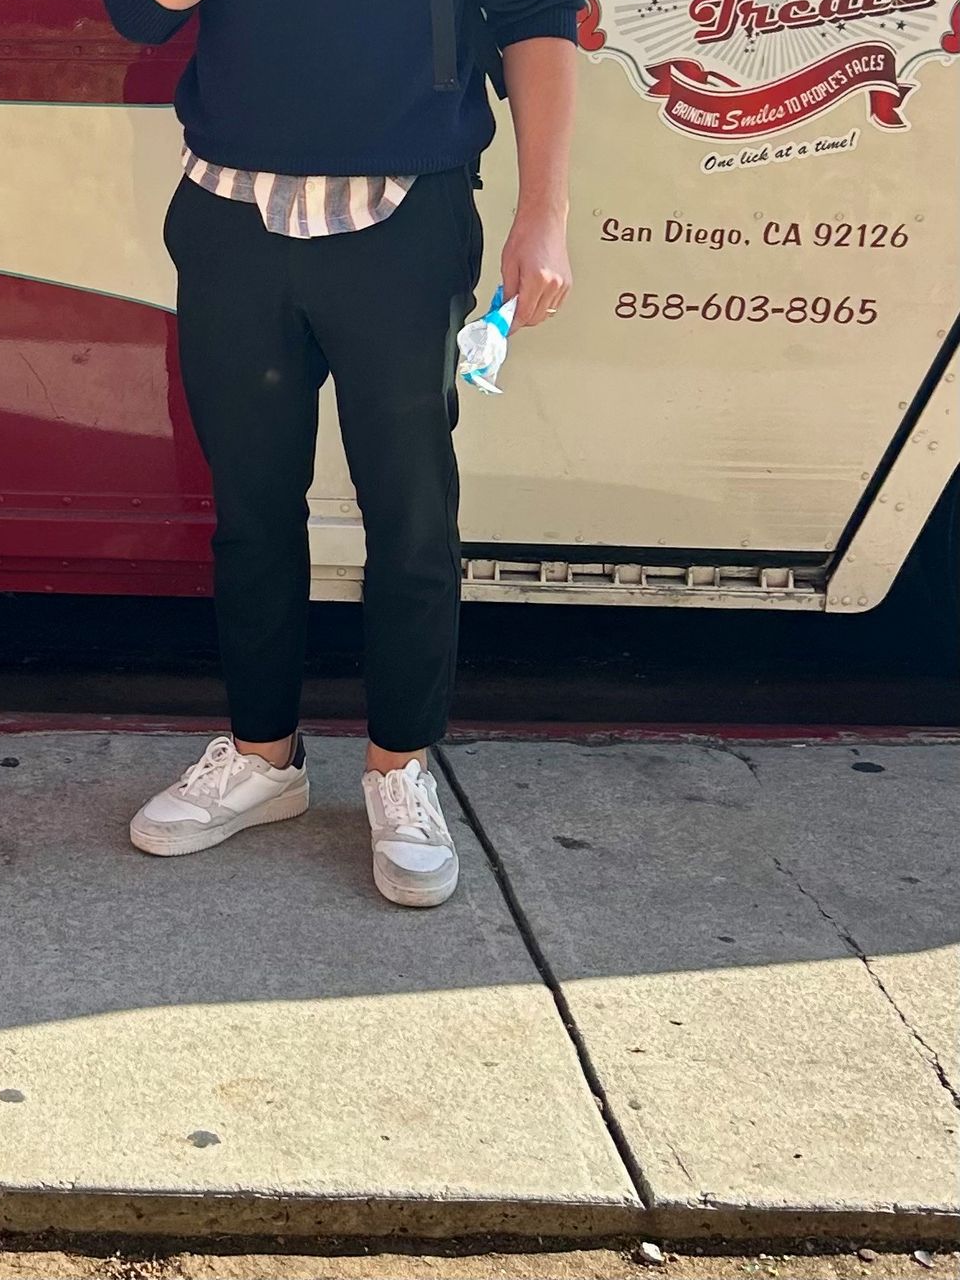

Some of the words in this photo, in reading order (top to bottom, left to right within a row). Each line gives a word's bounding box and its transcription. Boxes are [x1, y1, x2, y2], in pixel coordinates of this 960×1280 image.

[671, 100, 721, 128] BRINGING
[722, 104, 786, 131] Smiles
[786, 99, 802, 115] TO
[800, 70, 848, 108] PEOPLE'S
[845, 54, 886, 79] FACES
[704, 155, 734, 171] One
[740, 146, 769, 165] lick
[774, 146, 793, 159] at
[797, 146, 808, 156] a
[814, 132, 858, 153] time!
[600, 218, 653, 243] San
[664, 219, 750, 250] Diego,
[763, 221, 802, 247] CA
[812, 222, 909, 249] 92126
[614, 291, 878, 326] 858-603-8965
